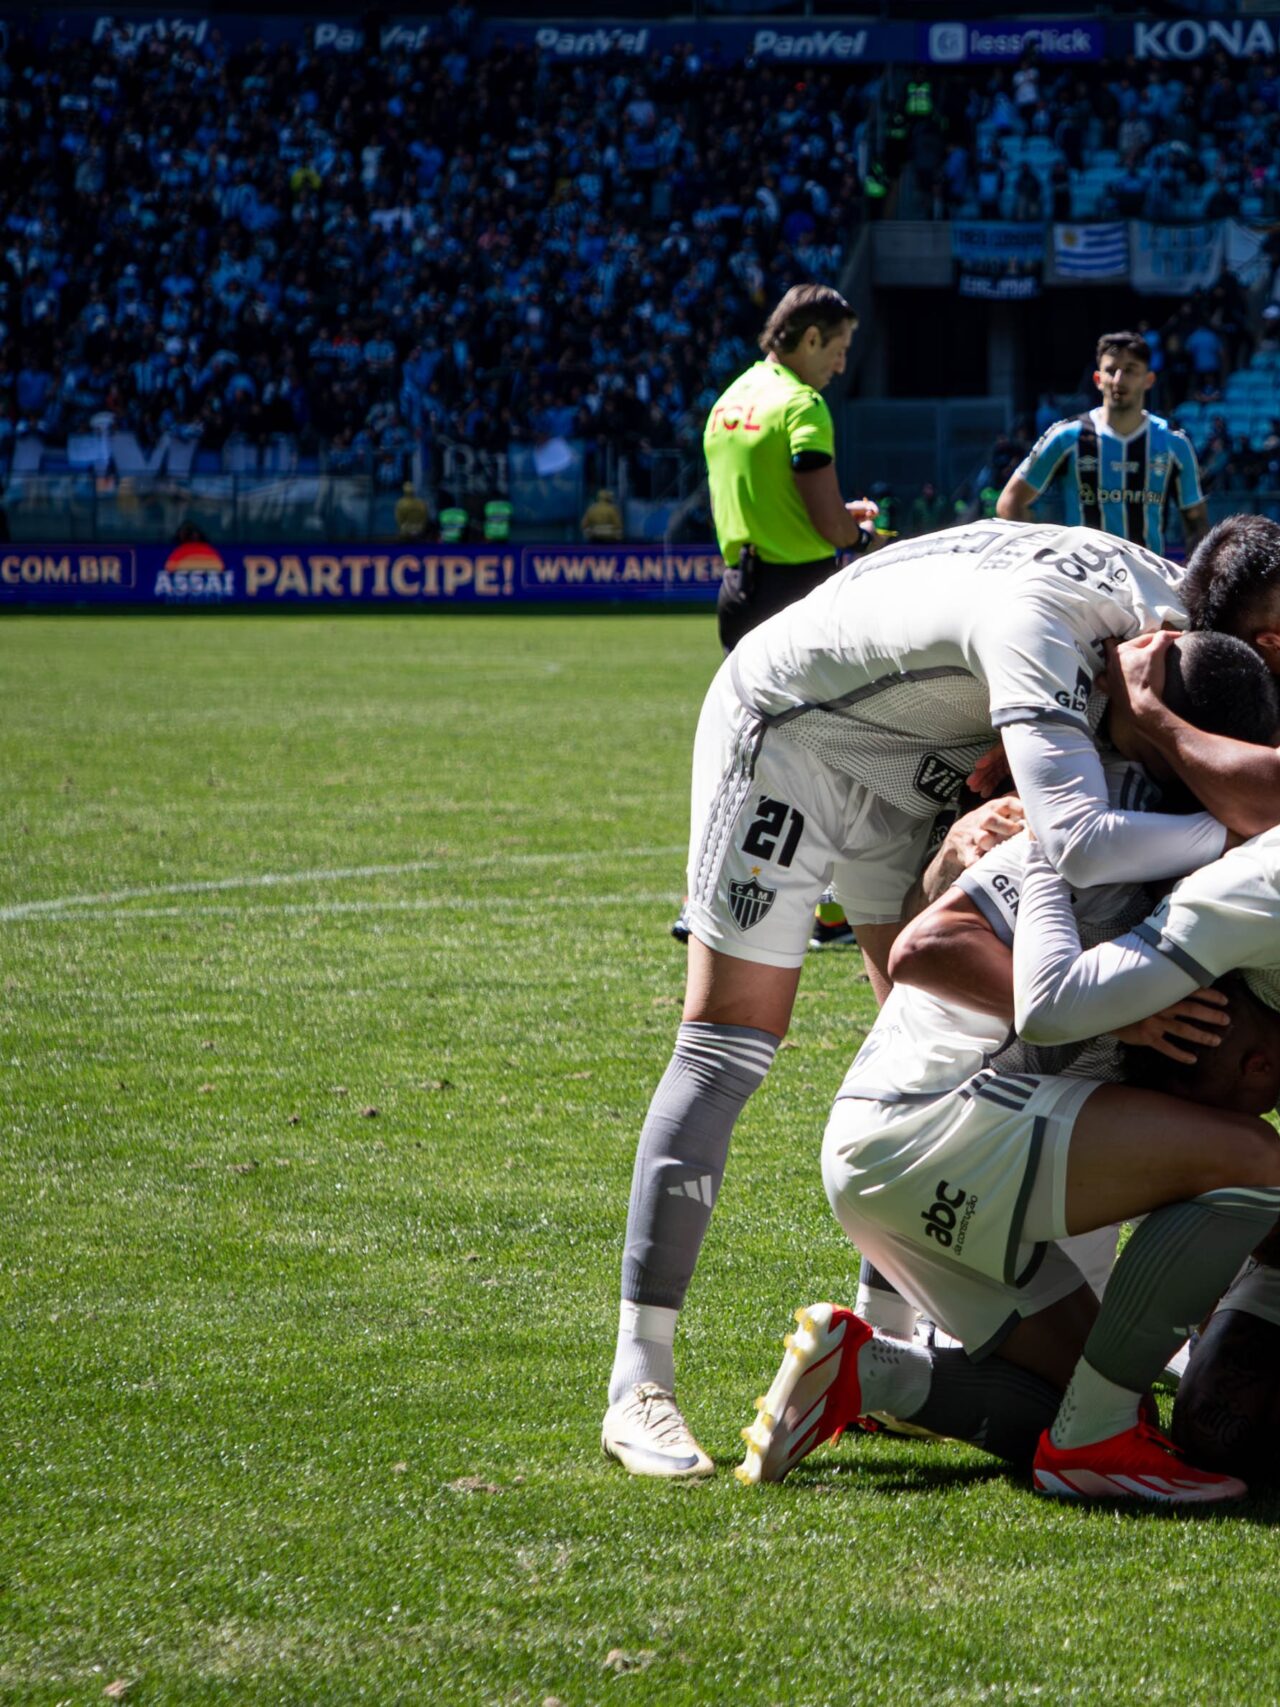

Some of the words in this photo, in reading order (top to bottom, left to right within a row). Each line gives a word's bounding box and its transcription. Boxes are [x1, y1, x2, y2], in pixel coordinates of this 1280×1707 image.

[313, 22, 429, 53] PaVel
[534, 27, 650, 57] PanVel
[753, 29, 869, 59] PanVel
[711, 405, 761, 432] TCL
[0, 553, 123, 585] COM.BR
[242, 553, 515, 599] PARTICIPE!
[531, 554, 724, 584] WWW.ANIVER
[741, 794, 805, 868] 21
[734, 884, 770, 902] CAM
[920, 1179, 967, 1248] abc
[957, 1194, 978, 1245] construção
